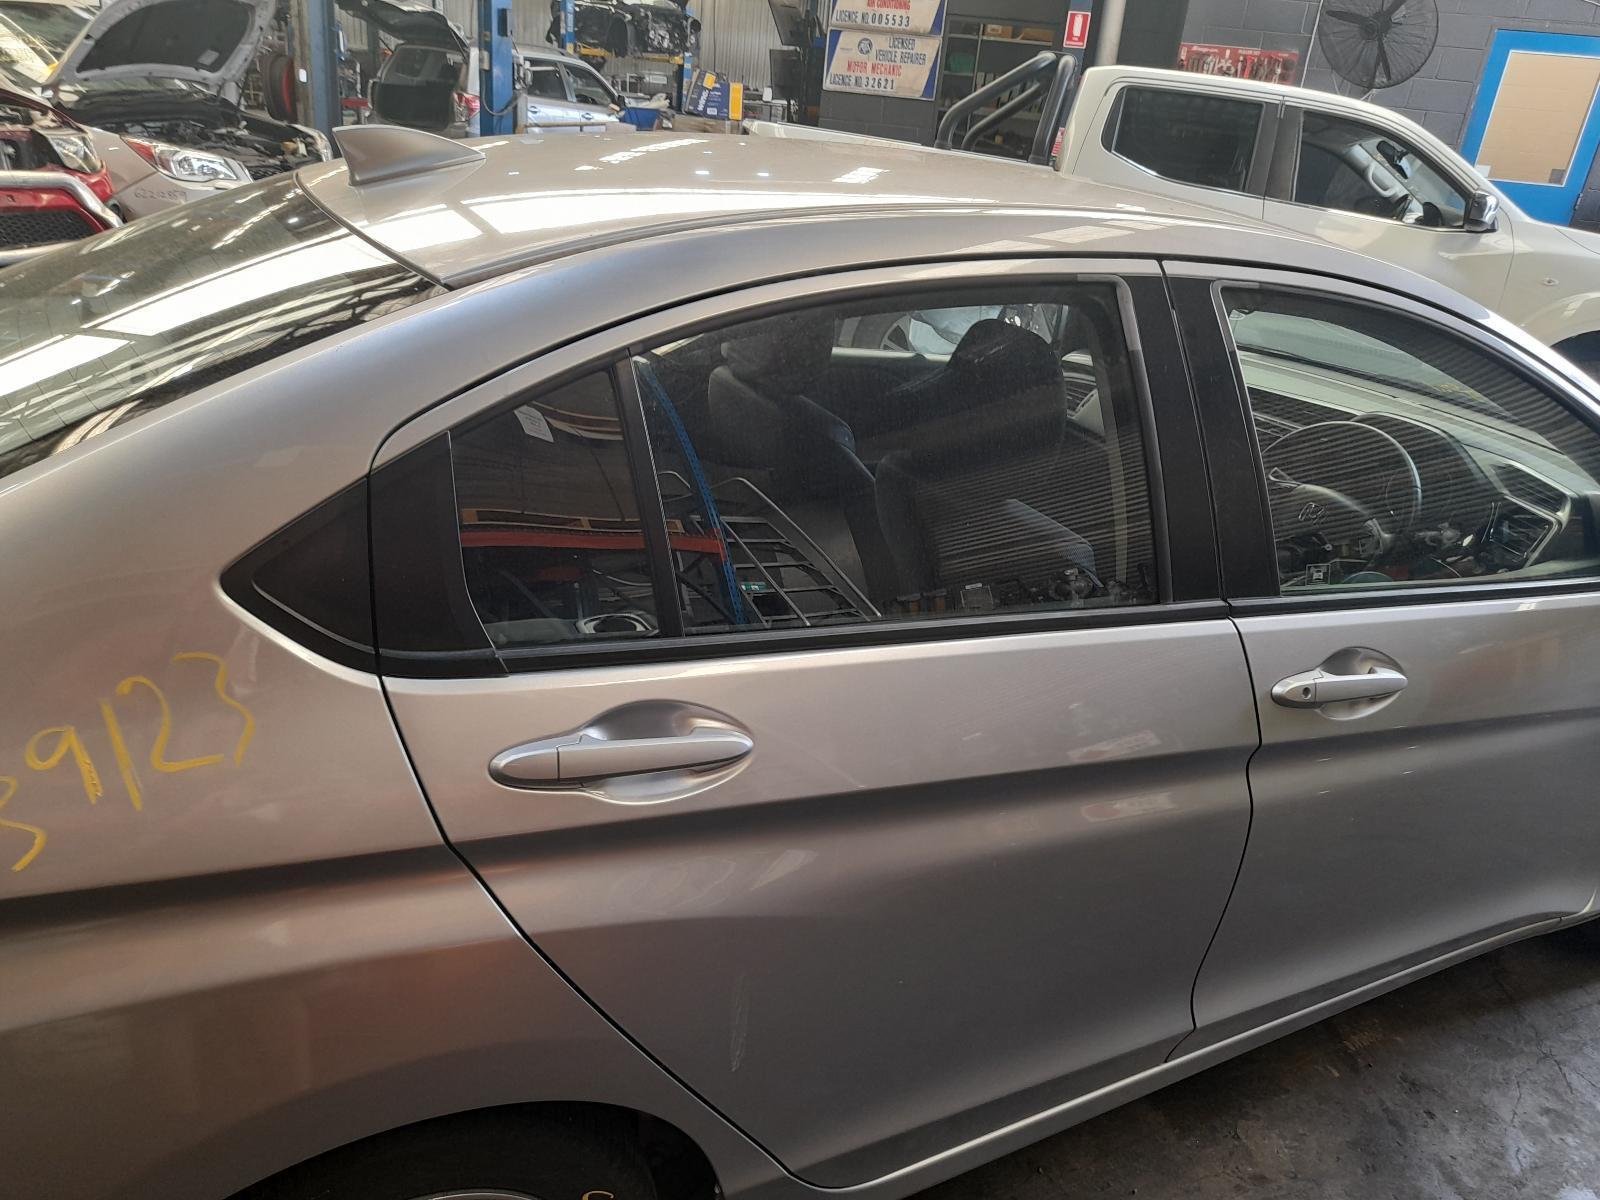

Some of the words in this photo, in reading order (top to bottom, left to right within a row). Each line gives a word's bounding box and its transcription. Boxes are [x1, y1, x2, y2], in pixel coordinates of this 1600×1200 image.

[835, 9, 859, 23] LICENCE
[871, 12, 910, 27] 005533
[888, 37, 916, 51] LICENSED
[875, 49, 898, 63] VEHICLE
[899, 51, 927, 66] REPAIRER
[847, 60, 867, 74] MOTOR
[871, 62, 902, 77] MECHANIC
[864, 76, 894, 90] 32621
